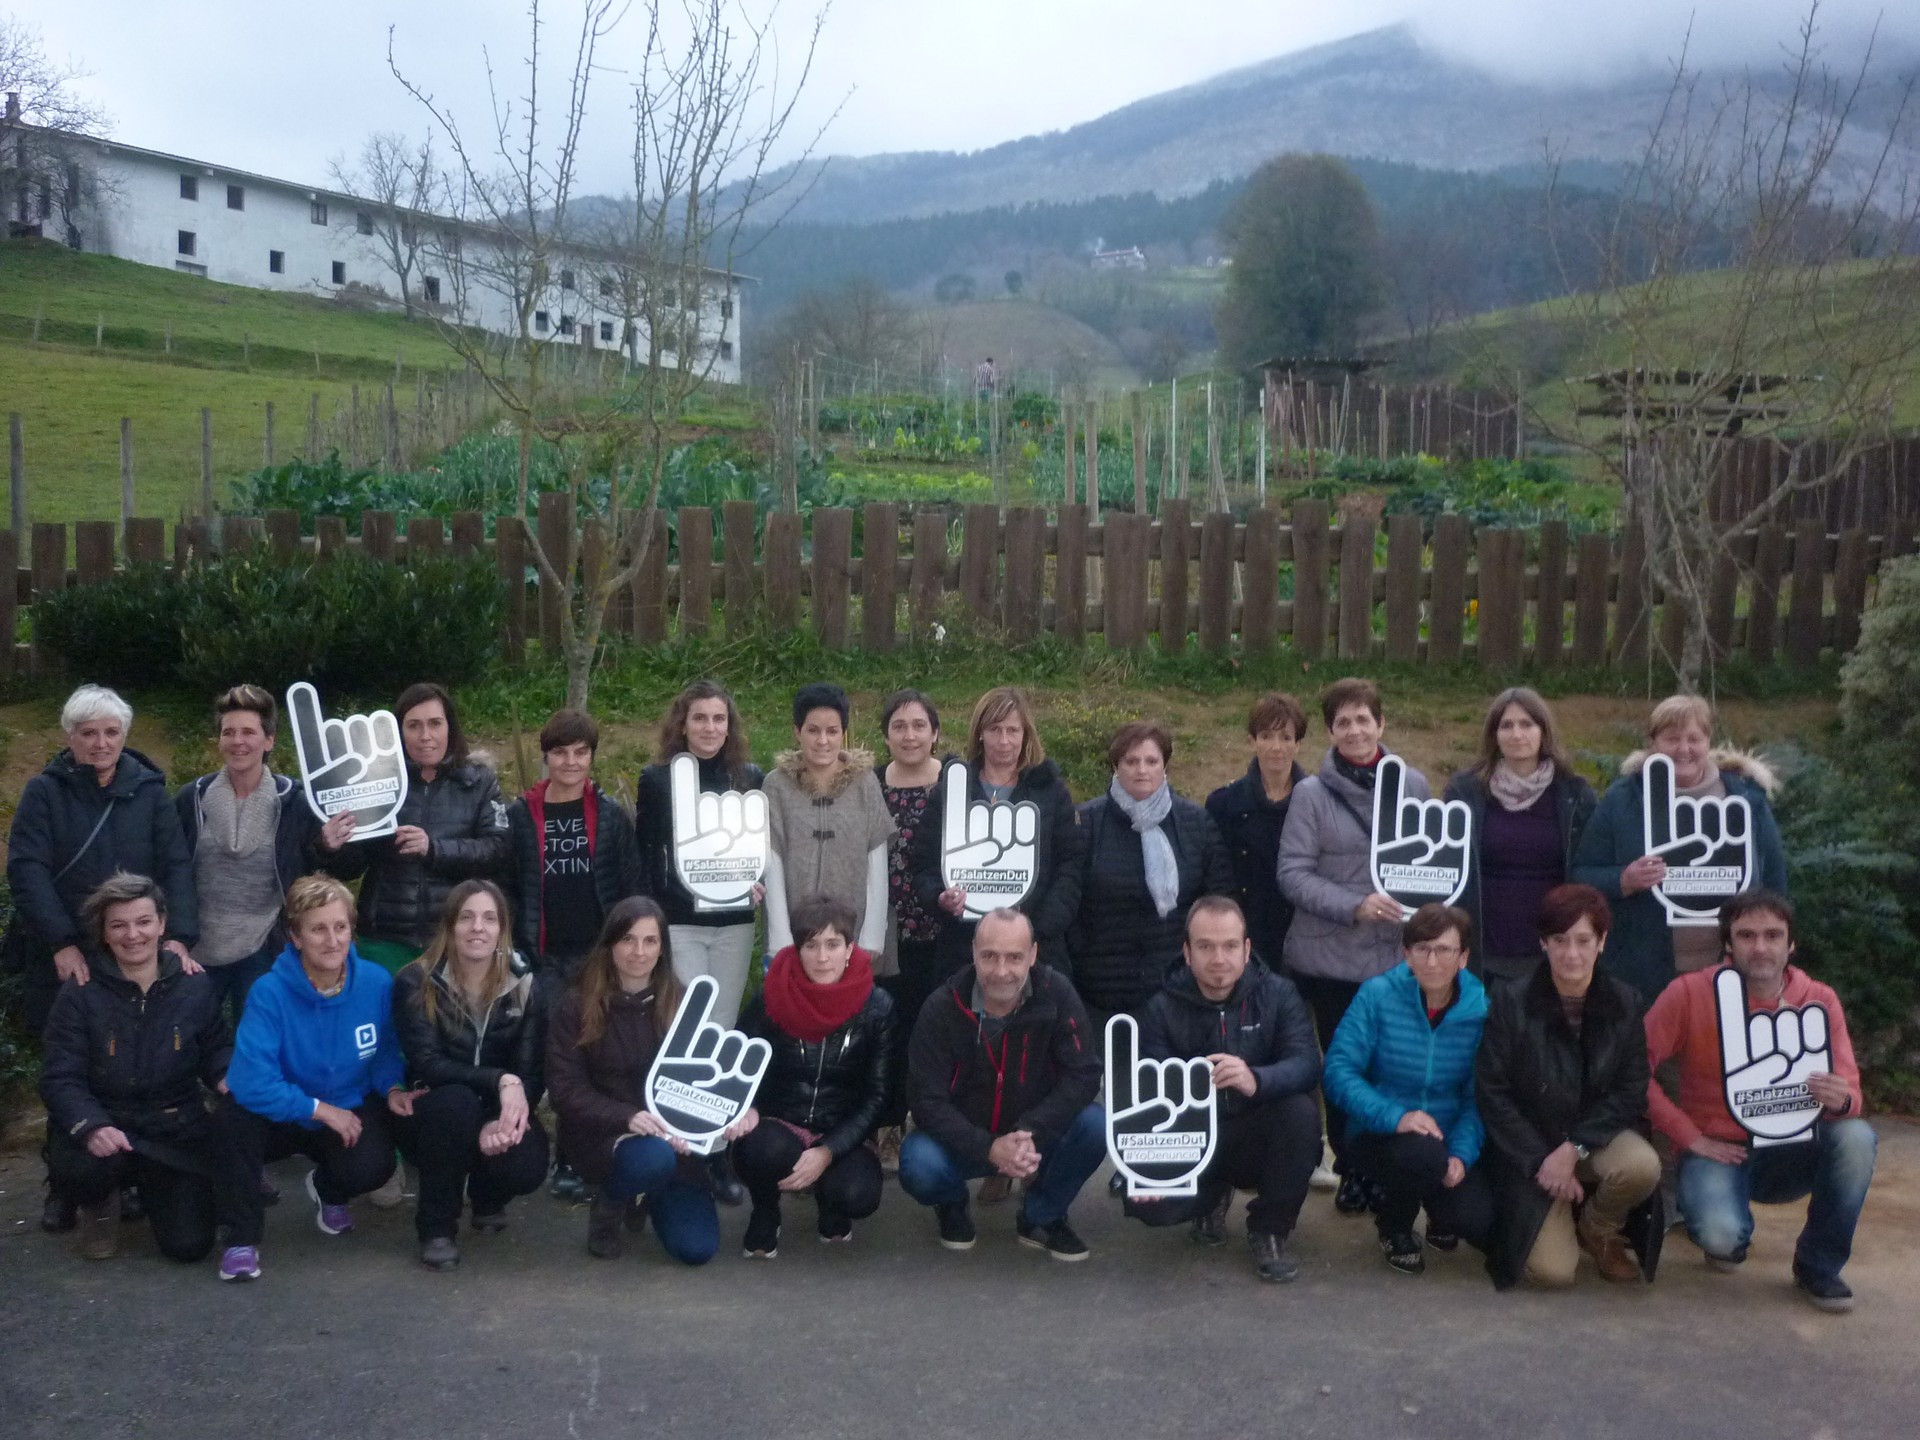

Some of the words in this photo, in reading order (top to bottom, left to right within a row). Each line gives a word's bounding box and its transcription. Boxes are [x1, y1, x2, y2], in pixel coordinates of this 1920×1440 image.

[320, 780, 397, 802] #SalatzenDut
[544, 818, 587, 832] EVE
[685, 858, 760, 871] #SalatzenDut
[690, 872, 756, 882] #YoDenuncio
[952, 869, 1028, 880] #SalatzenDut
[1383, 866, 1457, 879] #SalatzenDut
[1664, 868, 1740, 879] SalatzenDut
[959, 883, 1022, 893] YoDenuncio
[658, 1079, 735, 1113] #SalatzenDut
[1736, 1083, 1813, 1103] #SalatzenD
[1743, 1099, 1818, 1117] #YoDenuncio
[1121, 1134, 1204, 1146] #SalatzenDut
[1126, 1150, 1199, 1160] #YoDenuncio
